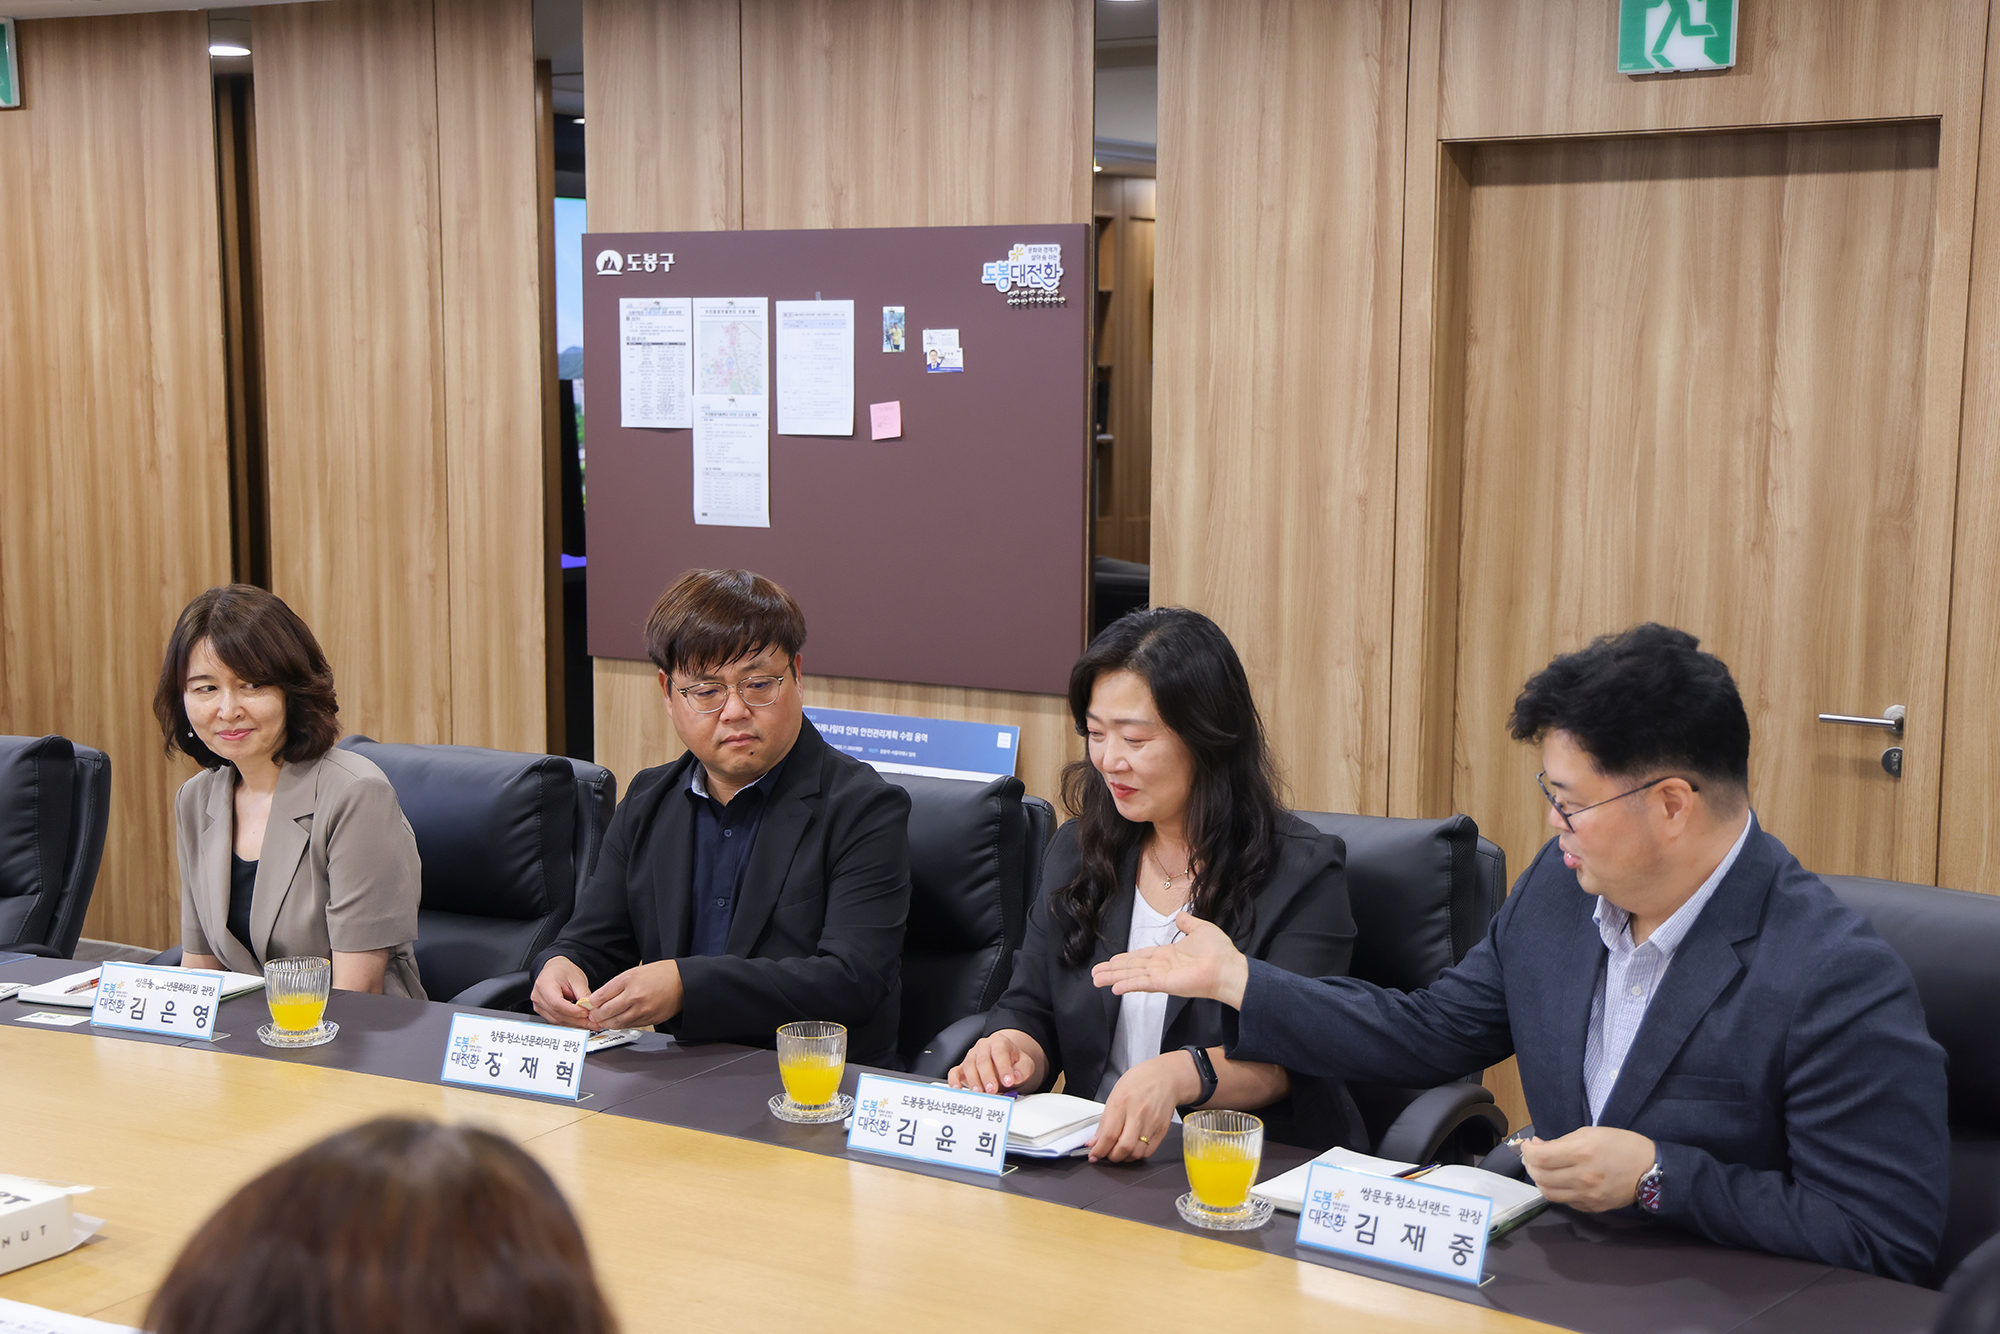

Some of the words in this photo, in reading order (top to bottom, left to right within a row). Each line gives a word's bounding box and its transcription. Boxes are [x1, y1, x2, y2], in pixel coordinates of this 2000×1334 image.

[626, 253, 676, 273] 도봉구
[984, 262, 1061, 290] 도봉대전환
[102, 983, 117, 998] 도봉
[135, 978, 199, 995] 쌍문동년문화의집
[201, 985, 216, 997] 관장
[99, 997, 125, 1013] 대전환
[454, 1036, 470, 1053] 도봉
[490, 1030, 560, 1050] 창동청소년문화의집
[562, 1040, 581, 1053] 관장
[451, 1052, 480, 1070] 대전환
[861, 1099, 878, 1117] 도봉
[901, 1095, 984, 1119] 도봉동청소년문화의집
[986, 1108, 1005, 1123] 관장
[857, 1116, 891, 1137] 대전환
[1312, 1189, 1333, 1211] 도봉
[1360, 1187, 1451, 1217] 쌍문동청소년랜드
[1458, 1207, 1483, 1225] 관장
[1308, 1208, 1347, 1233] 대전환
